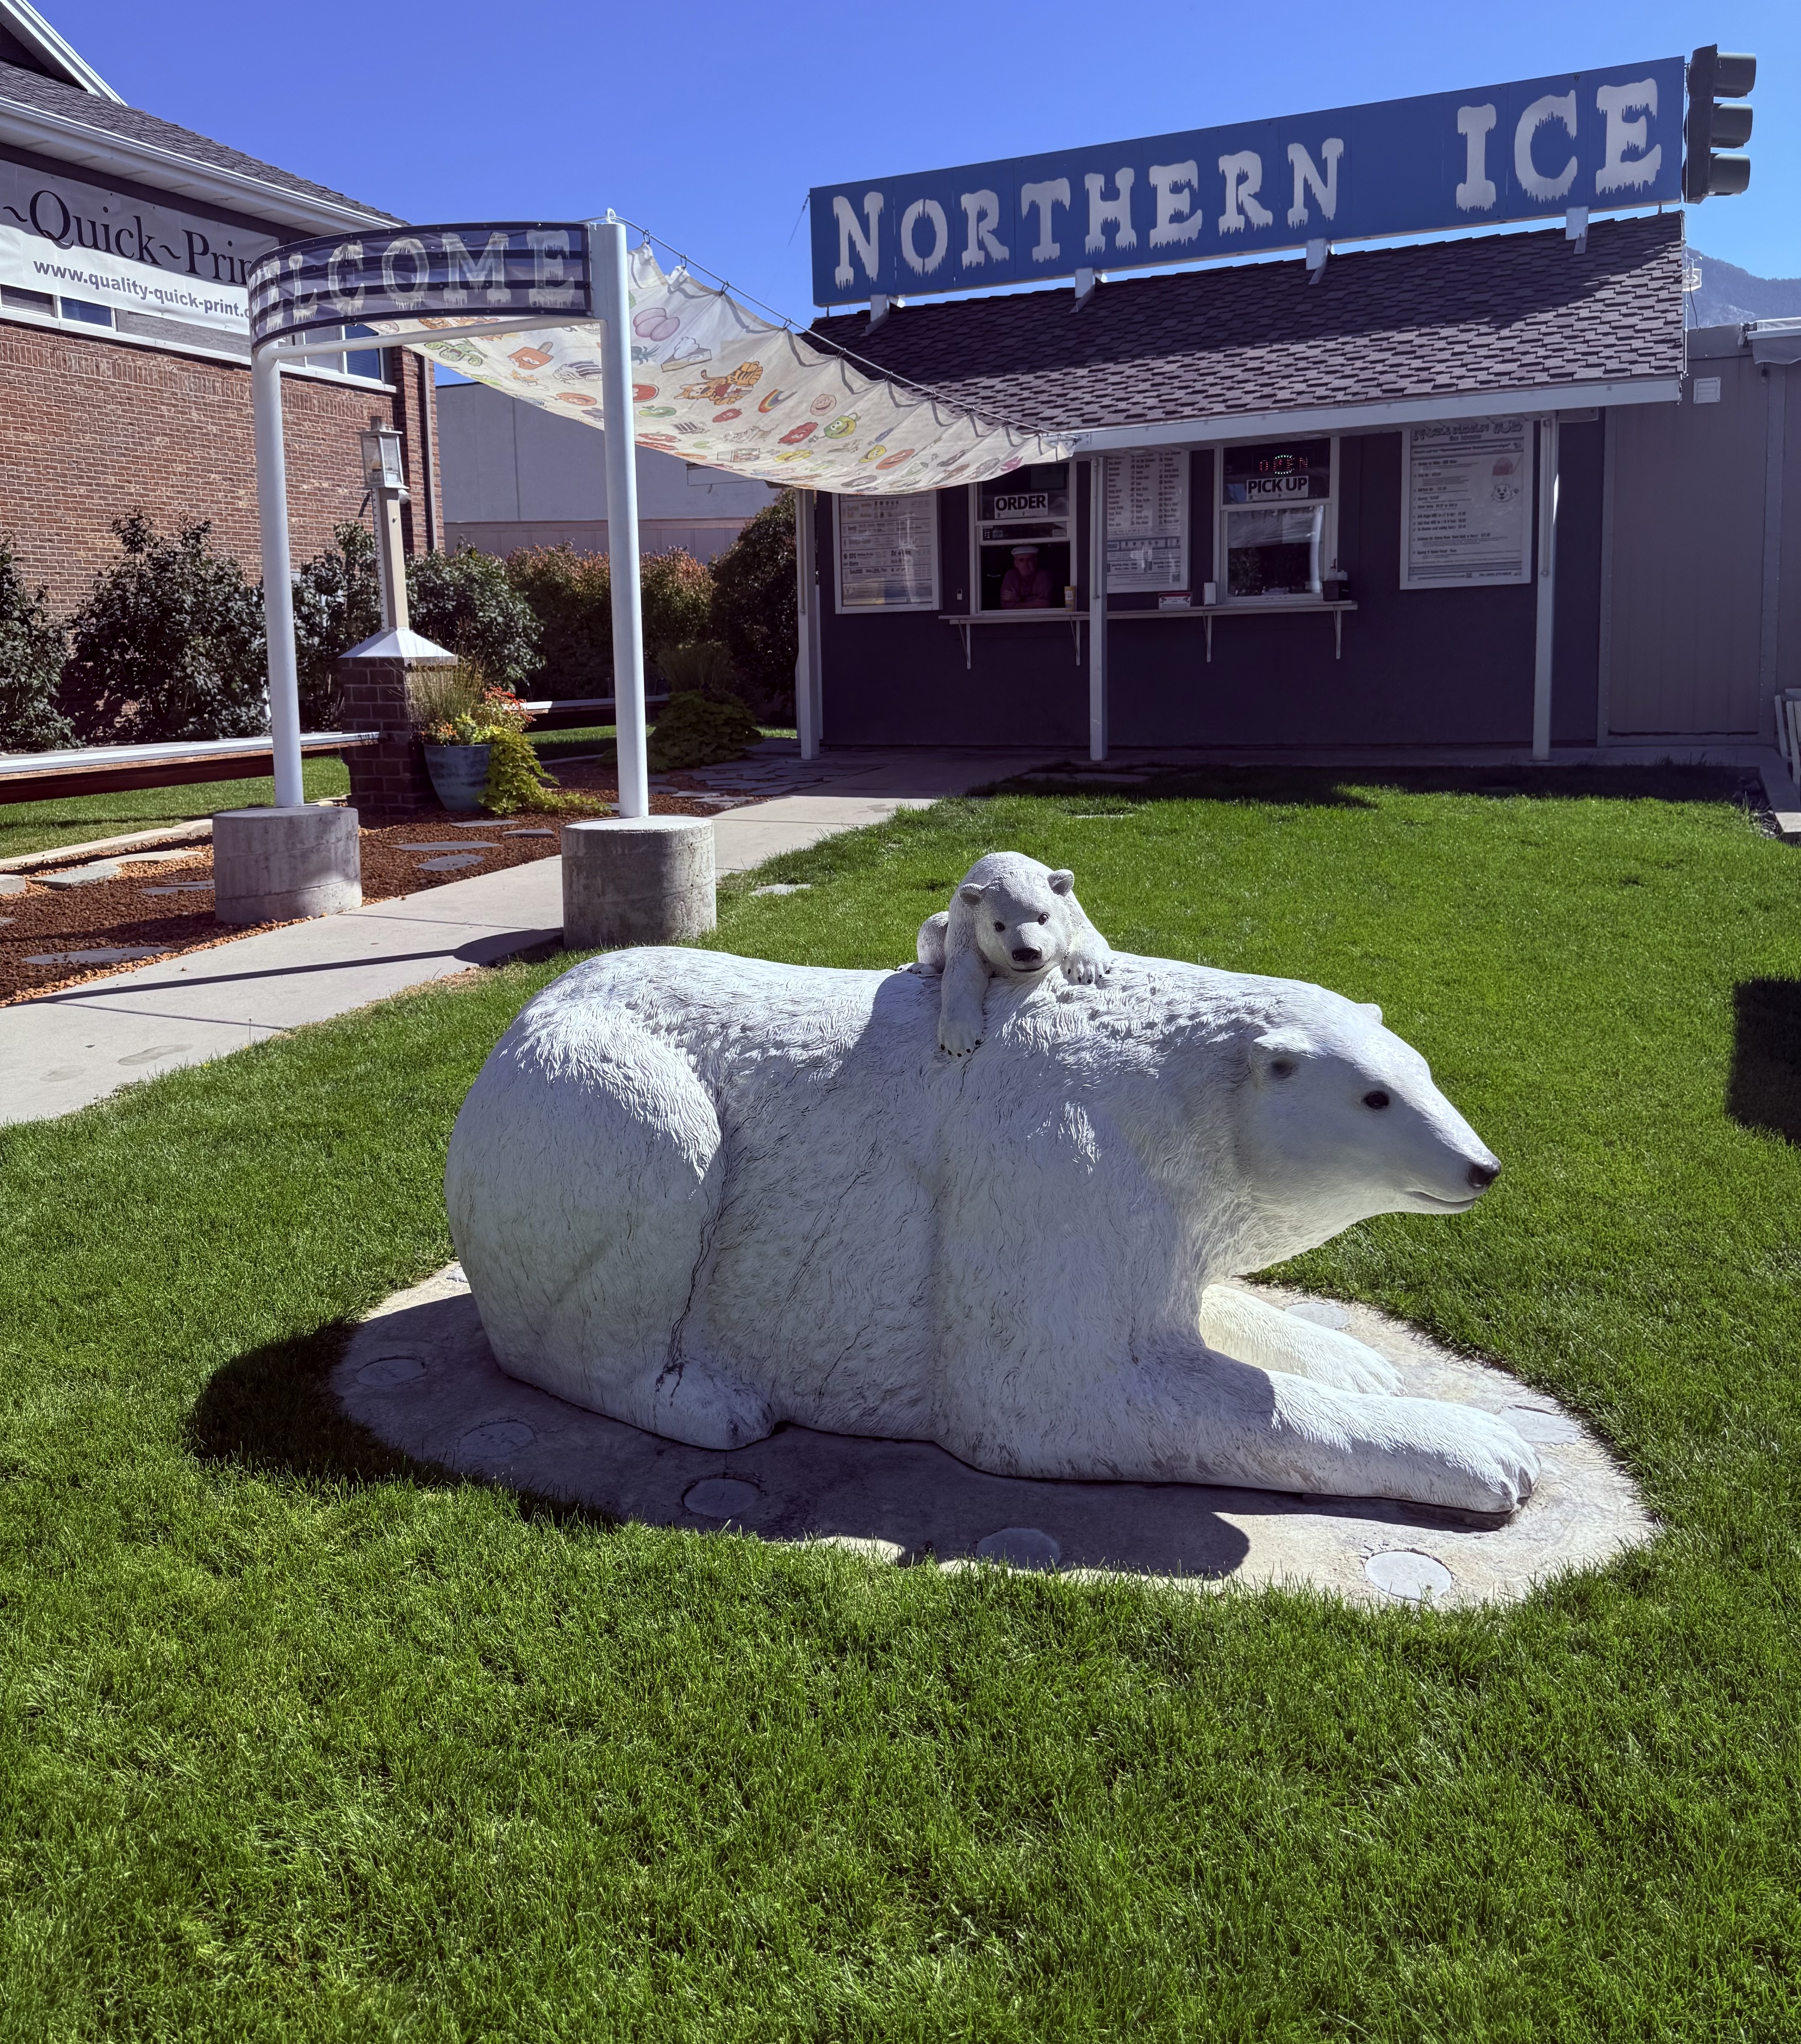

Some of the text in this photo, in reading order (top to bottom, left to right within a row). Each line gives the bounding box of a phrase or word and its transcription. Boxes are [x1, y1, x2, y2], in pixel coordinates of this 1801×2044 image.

[833, 77, 1662, 290] NORTHERN ICE
[1260, 457, 1308, 472] OPEN
[1248, 477, 1307, 494] PICK UP
[996, 495, 1047, 511] ORDER
